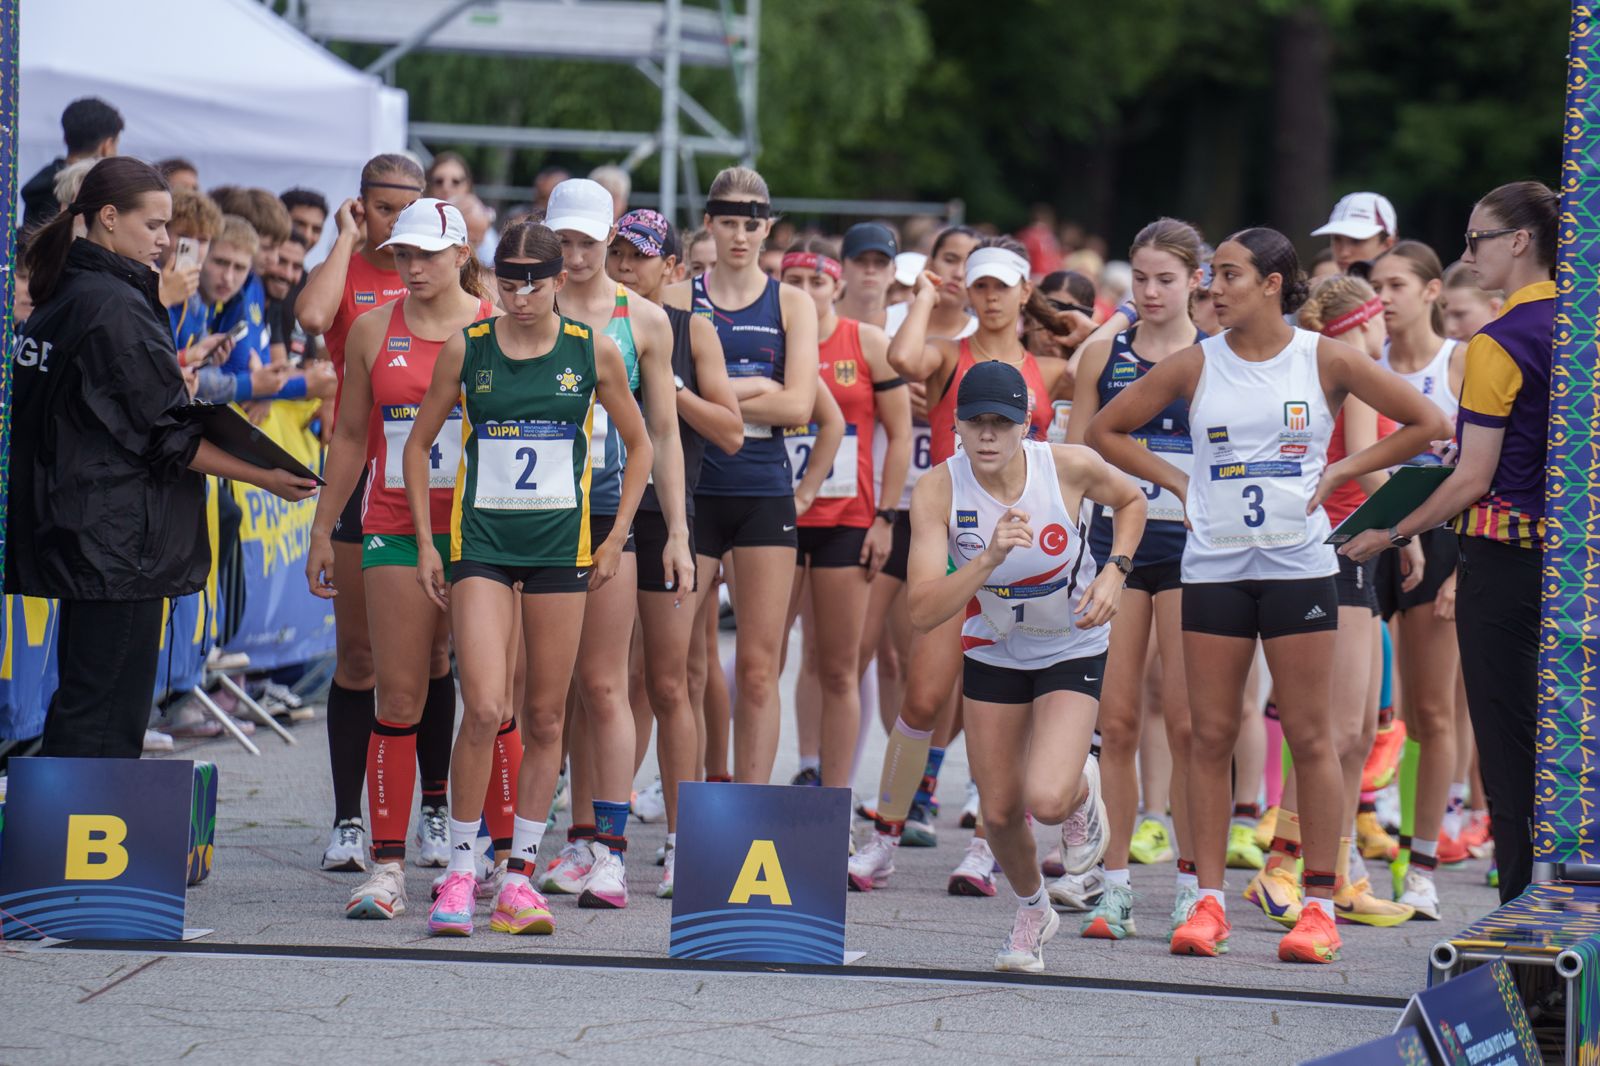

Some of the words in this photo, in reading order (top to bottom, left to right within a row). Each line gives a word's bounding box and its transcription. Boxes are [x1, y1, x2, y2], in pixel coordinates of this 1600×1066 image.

[391, 407, 420, 419] UIPM
[487, 425, 520, 437] UIPM
[515, 446, 538, 490] 2
[1219, 464, 1245, 478] UIPM
[1242, 484, 1266, 528] 3
[1011, 603, 1024, 623] 1
[64, 814, 129, 880] B
[727, 839, 793, 906] A
